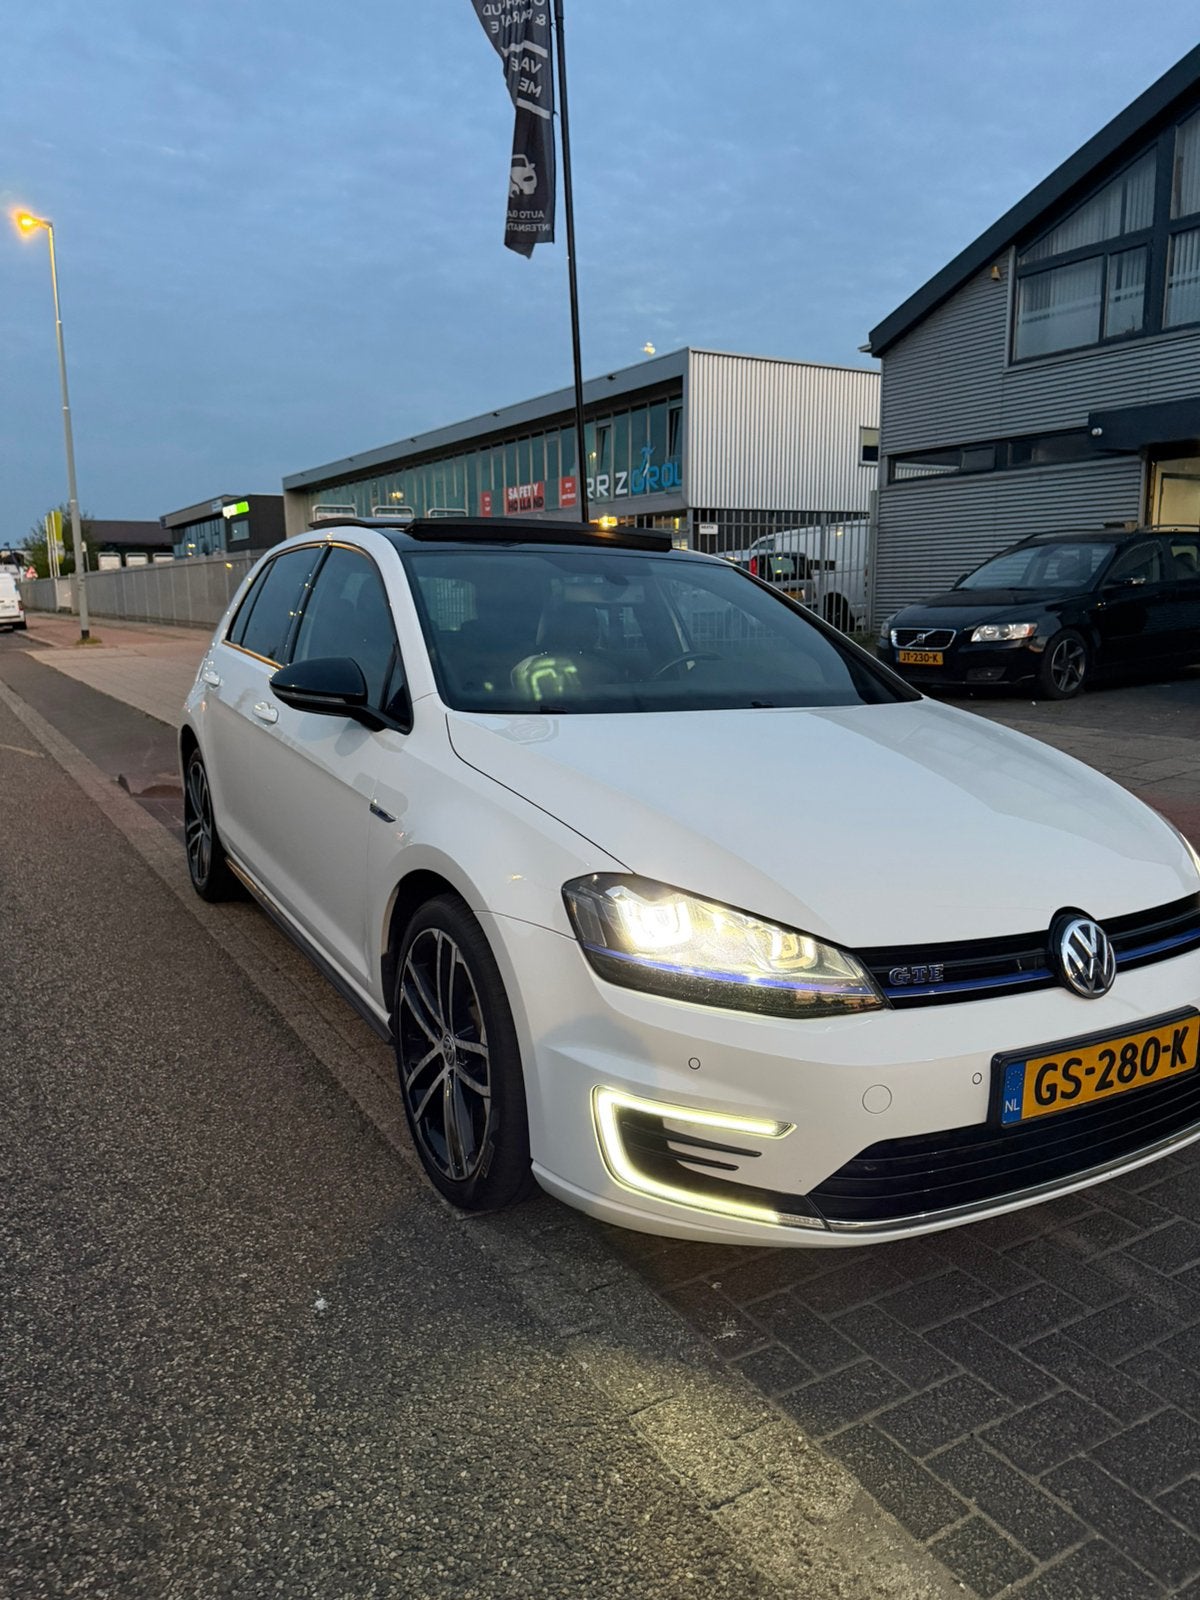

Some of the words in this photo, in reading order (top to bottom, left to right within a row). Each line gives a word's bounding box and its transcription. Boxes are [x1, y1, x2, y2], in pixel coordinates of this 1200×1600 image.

[508, 483, 539, 500] SAFETY
[508, 496, 544, 513] HOLLAND
[902, 652, 938, 663] JT-230-K
[888, 963, 944, 986] GTE
[1034, 1025, 1190, 1106] GS-280-K
[1004, 1099, 1020, 1113] NL
